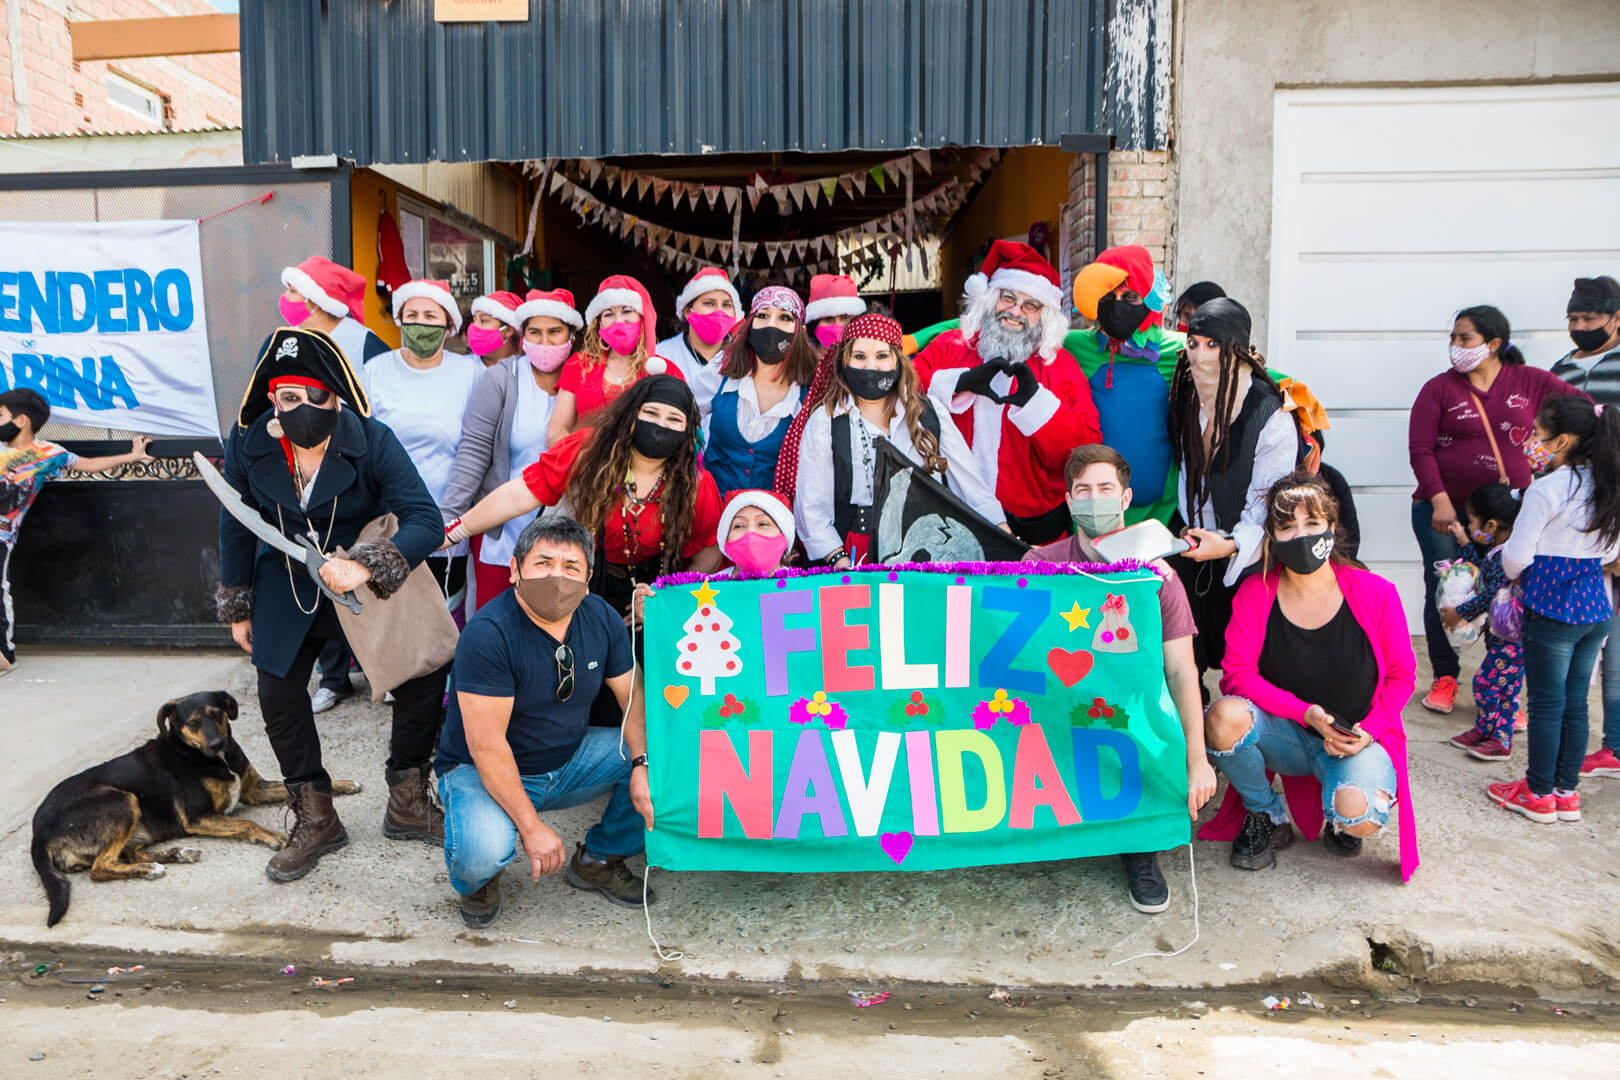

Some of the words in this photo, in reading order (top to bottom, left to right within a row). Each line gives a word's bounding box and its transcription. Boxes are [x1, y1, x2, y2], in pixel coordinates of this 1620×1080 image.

[0, 353, 140, 411] RINA
[760, 583, 1051, 696] FELIZ
[698, 723, 1142, 840] NAVIDAD
